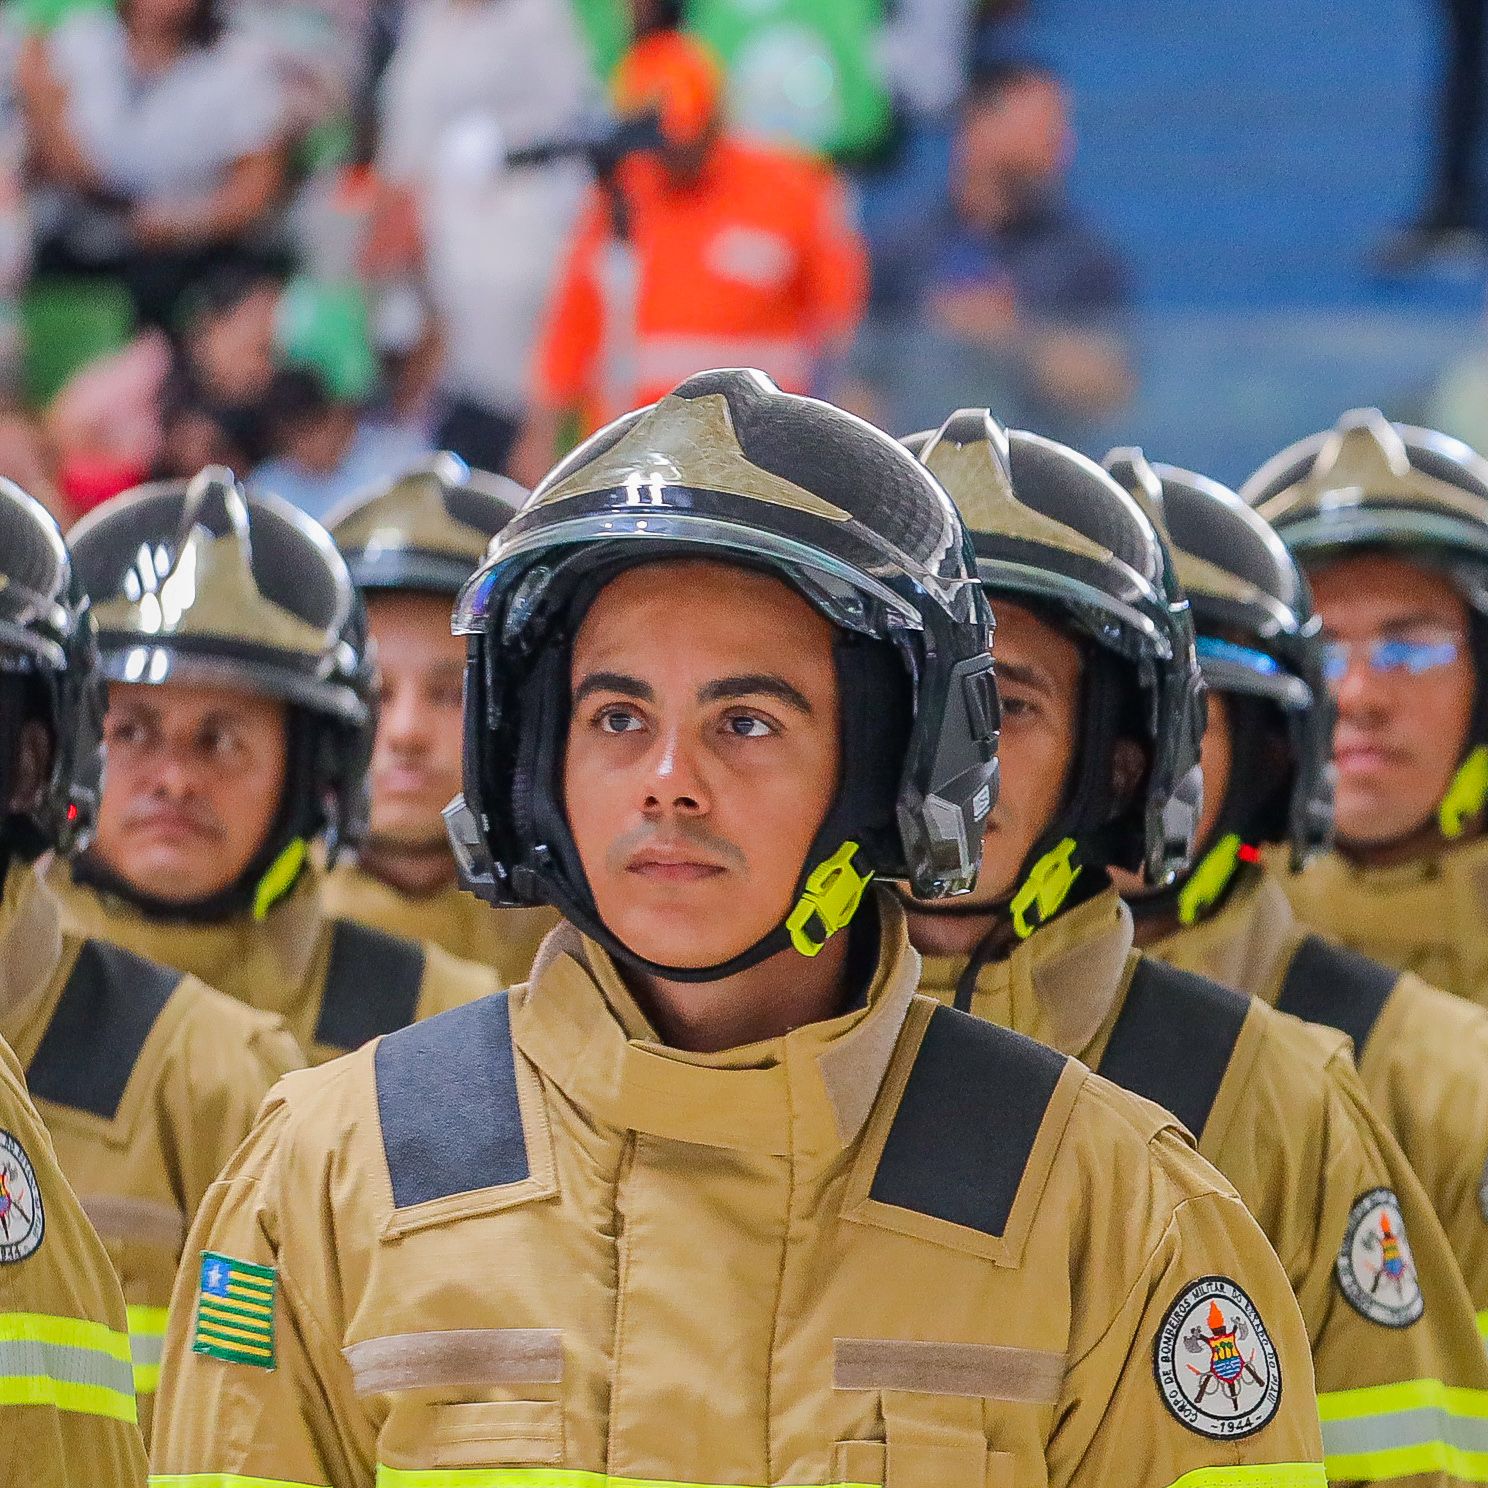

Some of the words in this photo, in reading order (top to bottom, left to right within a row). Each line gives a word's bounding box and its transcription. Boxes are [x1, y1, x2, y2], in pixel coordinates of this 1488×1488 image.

[1193, 1281, 1227, 1300] MILITAR
[1230, 1288, 1243, 1303] DO
[1161, 1299, 1191, 1363] BOMBEIROS
[1267, 1351, 1276, 1369] DO
[1162, 1369, 1174, 1385] DE
[1169, 1389, 1198, 1423] CORPO
